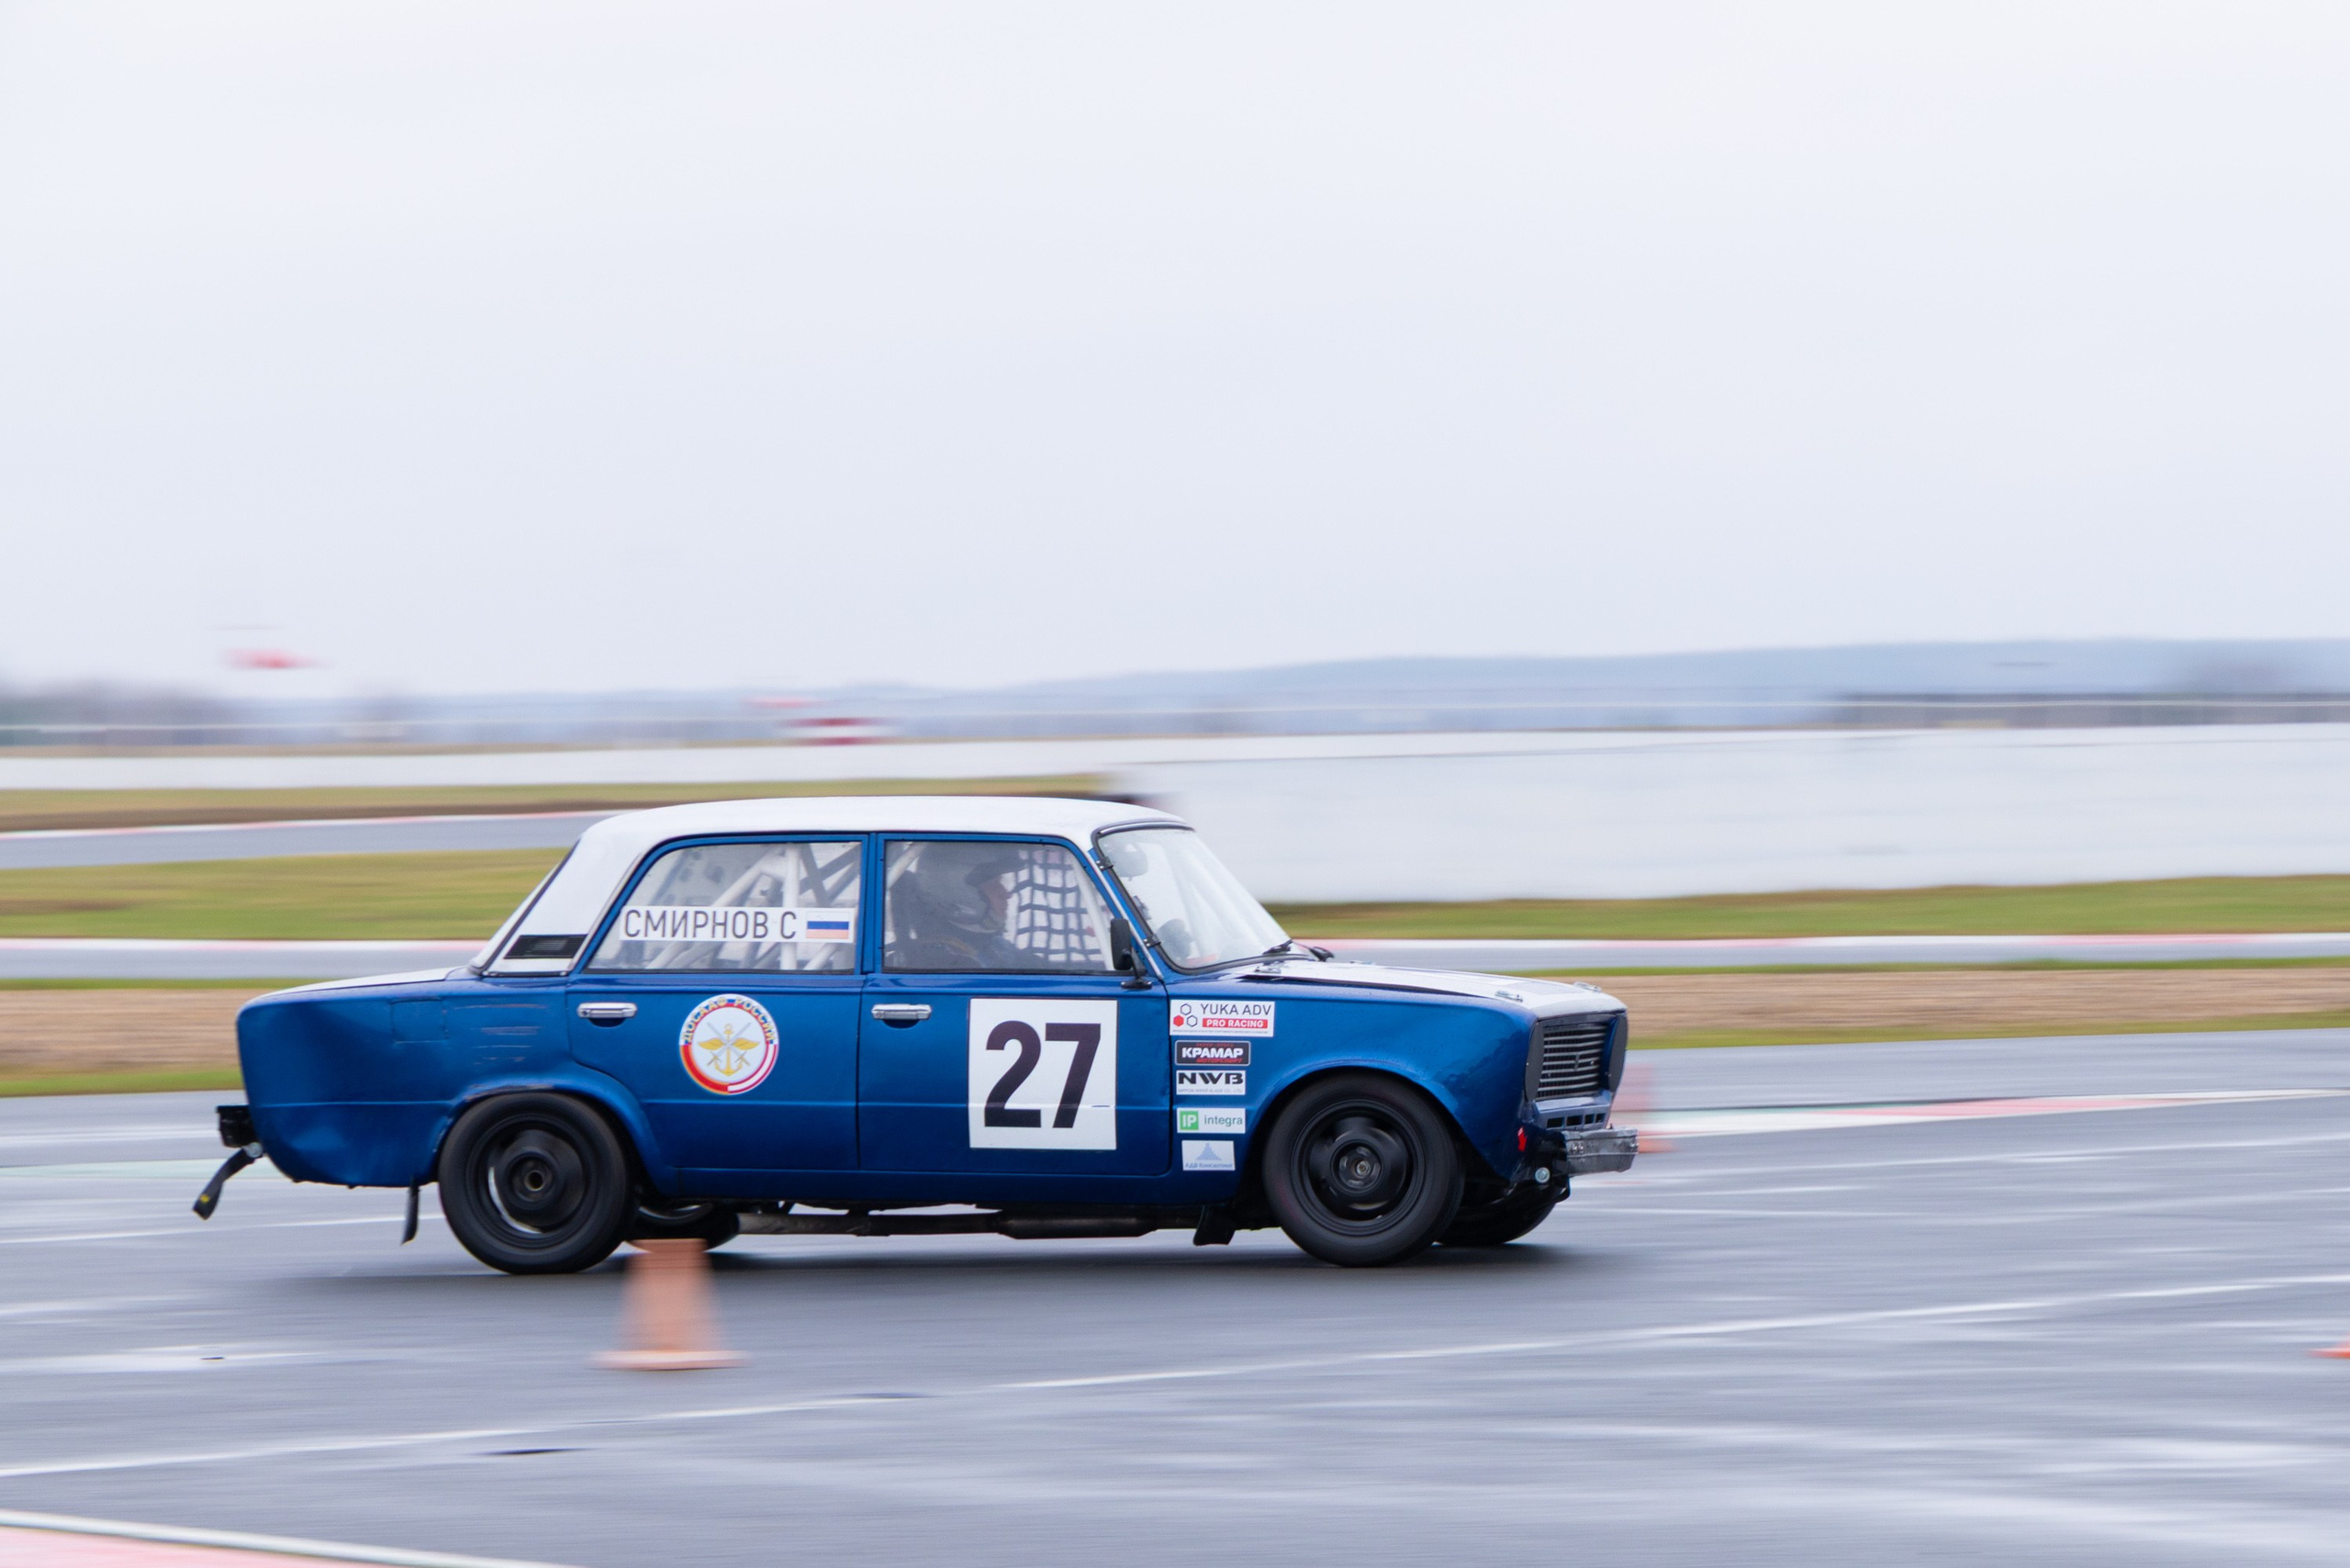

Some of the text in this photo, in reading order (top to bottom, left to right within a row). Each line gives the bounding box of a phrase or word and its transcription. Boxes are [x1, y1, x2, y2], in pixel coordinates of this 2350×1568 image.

[624, 909, 797, 939] СМИРНОВ С
[1200, 1003, 1272, 1016] YUKA ADV
[682, 997, 777, 1042] ДОСААФ РОССИИ
[1206, 1019, 1264, 1028] PRO RACING
[1181, 1047, 1244, 1058] КРАМАР
[984, 1020, 1102, 1128] 27
[1178, 1072, 1244, 1084] NWB
[1181, 1114, 1243, 1127] IP integra
